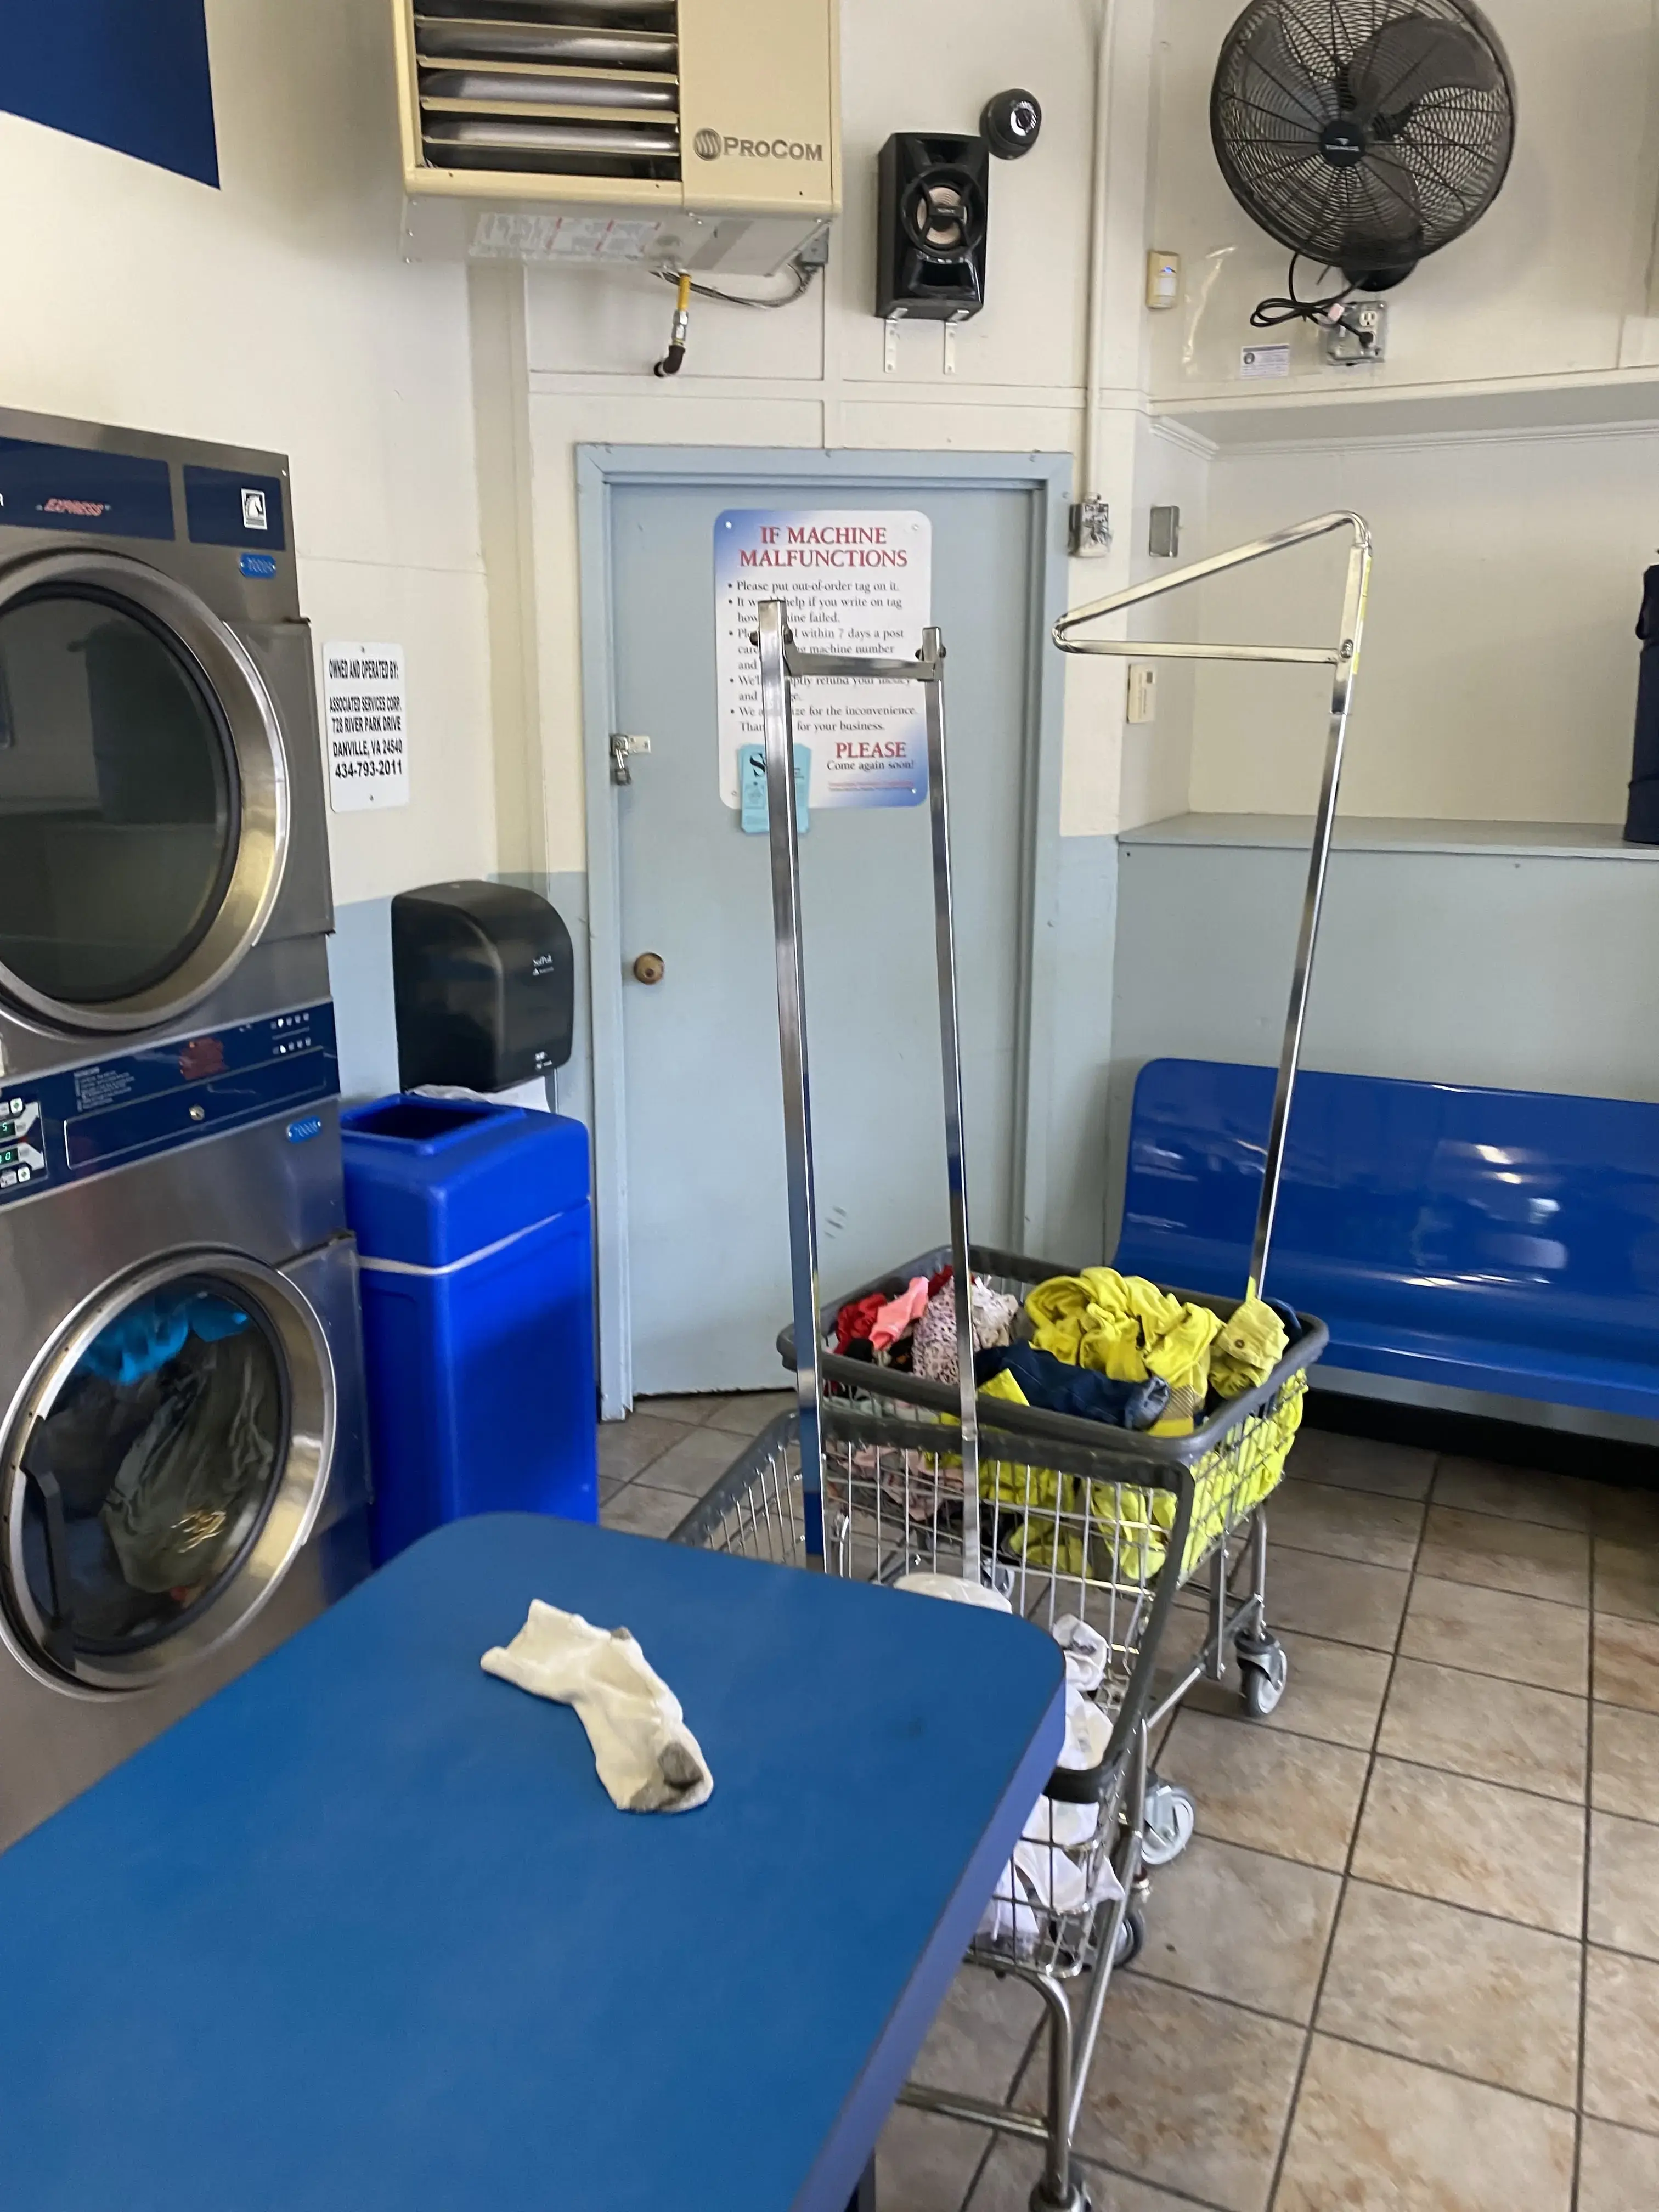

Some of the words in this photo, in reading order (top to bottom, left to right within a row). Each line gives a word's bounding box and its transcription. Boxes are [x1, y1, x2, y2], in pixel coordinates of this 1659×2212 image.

[760, 526, 781, 544] IF
[787, 526, 887, 545] MACHINE
[740, 549, 908, 567] MALFUNCTIONS
[737, 580, 769, 591] Please
[772, 583, 788, 594] put
[792, 579, 852, 591] out-of-order
[855, 582, 871, 594] tag
[737, 596, 744, 606] It
[809, 596, 817, 607] if
[819, 599, 838, 611] you
[840, 596, 868, 607] write
[870, 599, 883, 607] on
[887, 597, 902, 610] tag
[737, 612, 758, 623] how
[809, 611, 840, 623] failed.
[801, 628, 834, 639] within
[838, 628, 844, 639] 7
[848, 628, 871, 642] days
[883, 629, 904, 642] post
[810, 644, 853, 654] machine
[856, 643, 895, 654] number
[329, 659, 348, 679] OWNED
[349, 659, 360, 679] AND
[362, 659, 389, 680] OPERATED
[738, 658, 758, 669] and
[739, 690, 758, 701] and
[329, 696, 360, 713] ASSOCIATED
[362, 696, 386, 712] SERVICES
[739, 706, 755, 716] We
[809, 704, 825, 716] for
[826, 704, 842, 716] the
[345, 716, 364, 733] RIVER
[364, 716, 382, 732] PARK
[382, 715, 402, 732] DRIVE
[797, 720, 811, 731] for
[813, 723, 838, 735] your
[839, 719, 885, 731] business.
[332, 740, 370, 758] DANVILLE,
[371, 740, 381, 755] VA
[382, 738, 403, 755] 24540
[836, 742, 907, 759] PLEASE
[335, 759, 402, 780] 434-793-2011
[827, 760, 856, 771] Come
[859, 759, 885, 772] again
[888, 759, 915, 769] soon!
